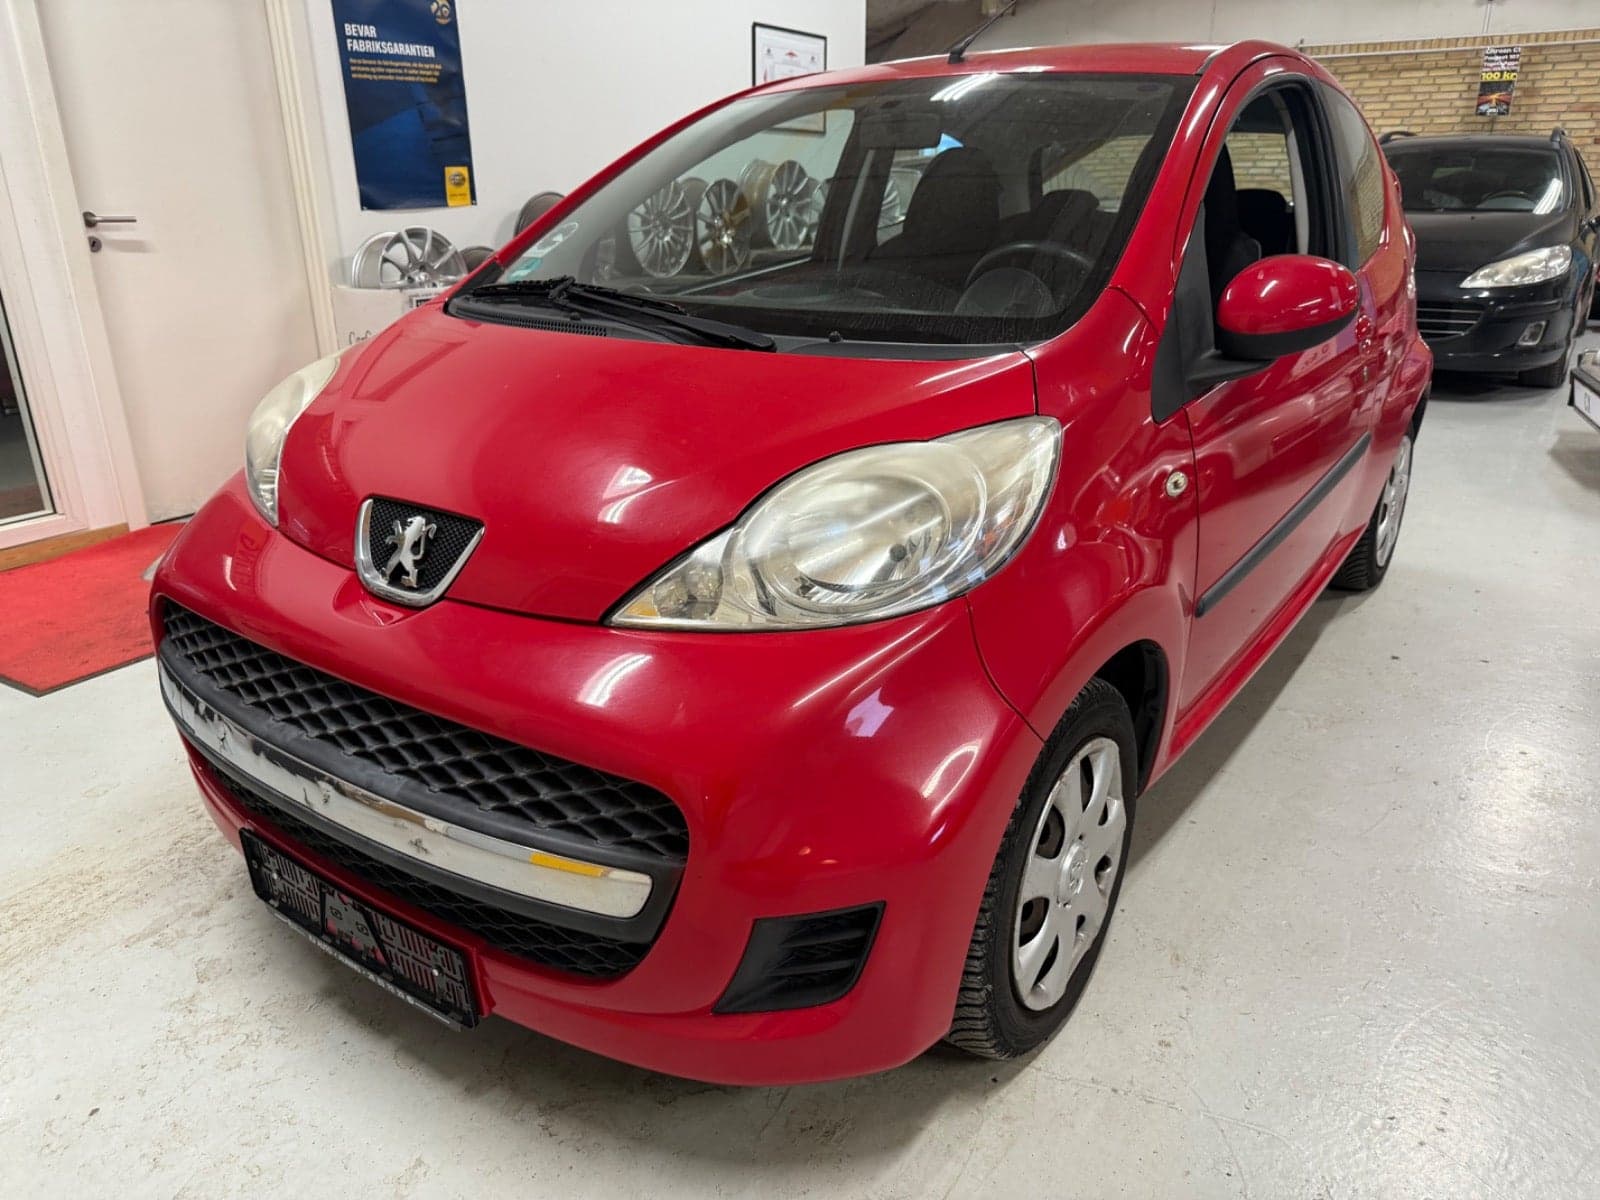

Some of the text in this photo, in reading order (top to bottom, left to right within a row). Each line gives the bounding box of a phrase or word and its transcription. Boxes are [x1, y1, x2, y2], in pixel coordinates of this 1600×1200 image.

[344, 23, 377, 38] BEVAR
[346, 39, 436, 58] FABRIKSGARANTIEN
[1481, 72, 1501, 80] 100
